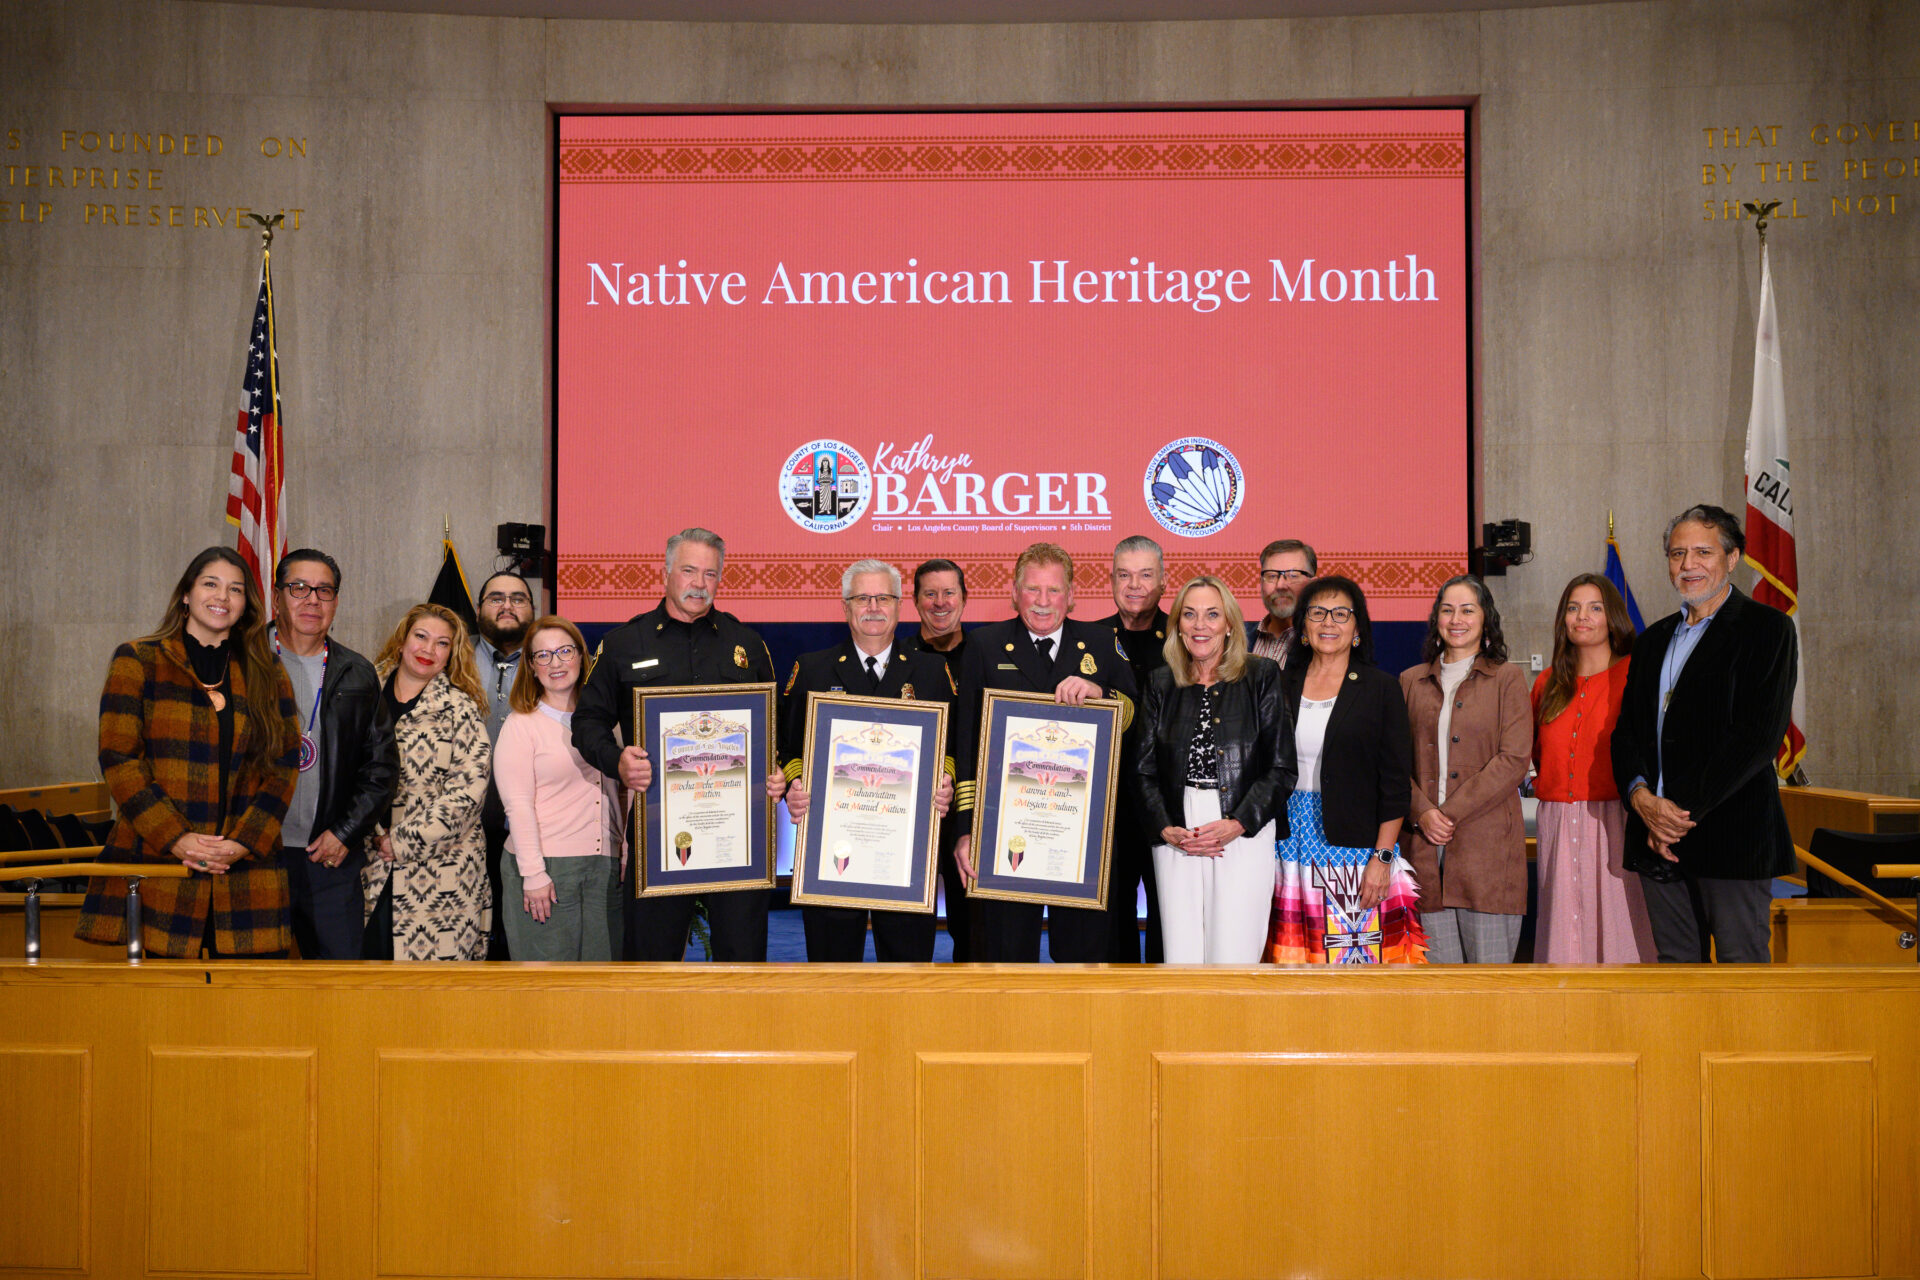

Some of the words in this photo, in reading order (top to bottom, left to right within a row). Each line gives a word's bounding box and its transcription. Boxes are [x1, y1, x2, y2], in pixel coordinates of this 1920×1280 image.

[61, 130, 224, 156] FOUNDED
[260, 137, 307, 158] ON
[1702, 125, 1783, 149] THAT
[4, 165, 163, 190] TERPRISE
[1702, 163, 1737, 185] BY
[1755, 160, 1819, 183] THE
[85, 203, 252, 229] PRESERVE
[279, 208, 305, 231] IT
[1832, 193, 1902, 217] NOT
[586, 259, 747, 306] Native
[761, 257, 1013, 306] American
[1028, 256, 1251, 313] Heritage
[1268, 254, 1439, 302] Month
[786, 446, 809, 471] COUNTY
[810, 442, 821, 450] OF
[823, 441, 838, 449] LOS
[839, 445, 866, 471] ANGELES
[872, 433, 973, 485] Kathryn
[1146, 458, 1159, 480] NATIVE
[1157, 437, 1190, 460] AMERICAN
[1190, 437, 1215, 447] INDIAN
[1215, 442, 1243, 481] COMMISSION
[872, 472, 1112, 515] BARGER
[1753, 471, 1794, 516] CAL
[803, 519, 848, 531] CALIFORNIA
[872, 523, 893, 532] Chair
[907, 523, 921, 532] Los
[922, 523, 951, 534] Angeles
[952, 523, 979, 534] County
[981, 523, 1003, 532] Board
[1004, 523, 1013, 532] of
[1014, 523, 1057, 534] Supervisors
[1069, 523, 1083, 532] 5th
[1084, 523, 1112, 532] District
[1147, 498, 1156, 512] LOS
[1153, 511, 1177, 533] ANGELES
[1178, 523, 1222, 536] CITY/COUNTY
[683, 753, 729, 764] Commendation
[1025, 760, 1071, 773] Commendation
